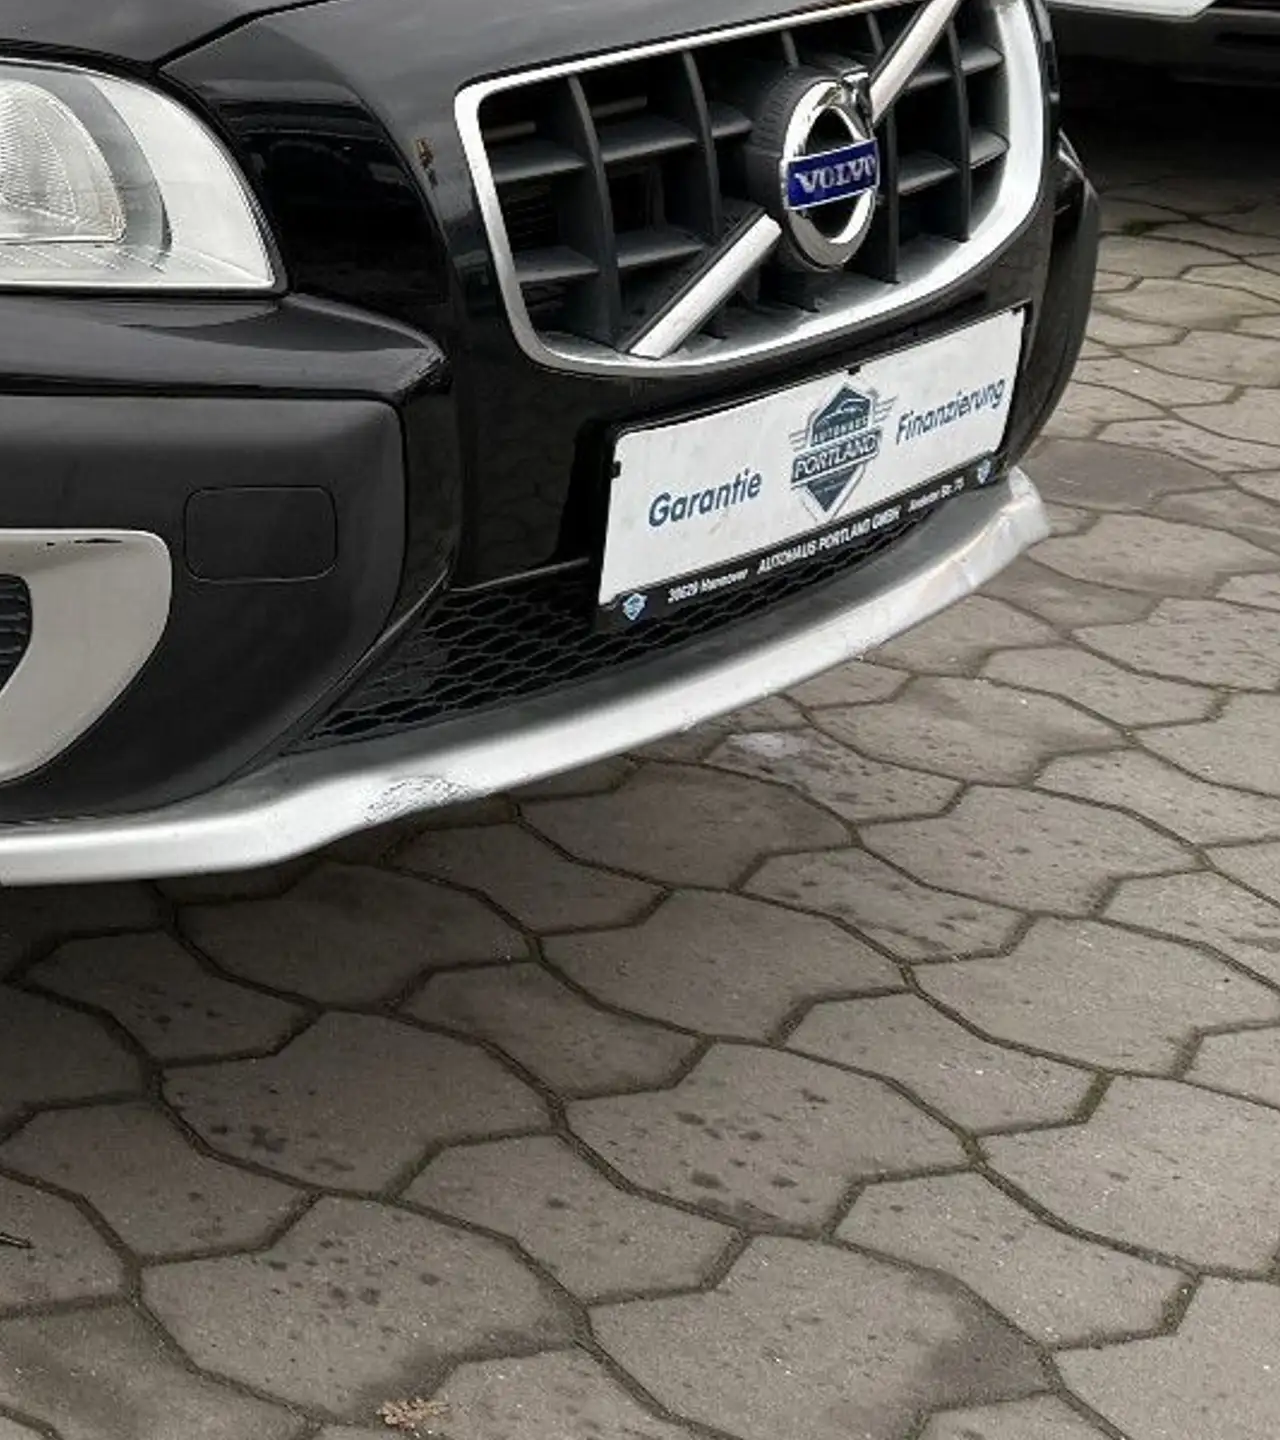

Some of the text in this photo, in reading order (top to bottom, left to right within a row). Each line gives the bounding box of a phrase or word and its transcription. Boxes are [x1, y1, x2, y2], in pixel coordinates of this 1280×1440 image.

[795, 155, 875, 193] VOLVO
[896, 378, 1005, 445] Finanzierung
[795, 435, 878, 480] PORTLAND
[648, 472, 762, 528] Garantie
[756, 539, 817, 574] AUTOHAUS
[819, 518, 870, 551] PORTLAND
